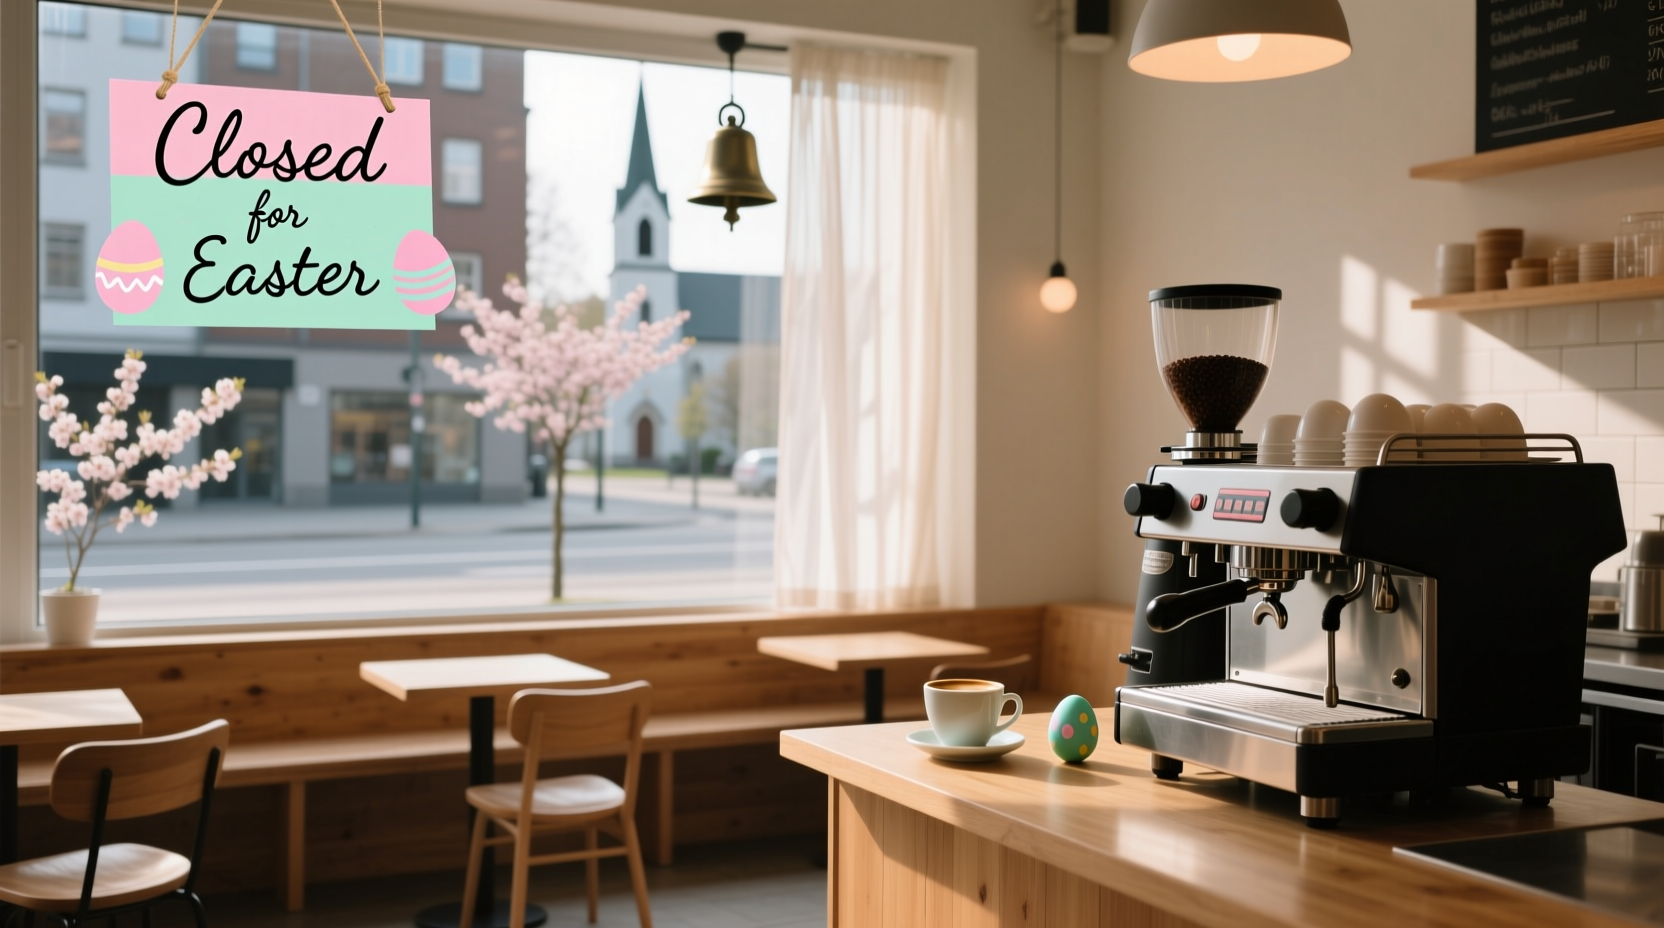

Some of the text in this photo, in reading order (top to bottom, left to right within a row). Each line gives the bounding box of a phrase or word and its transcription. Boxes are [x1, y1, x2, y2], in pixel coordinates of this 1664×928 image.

[155, 101, 387, 186] Closed
[247, 189, 308, 244] for
[184, 235, 380, 303] Easter
